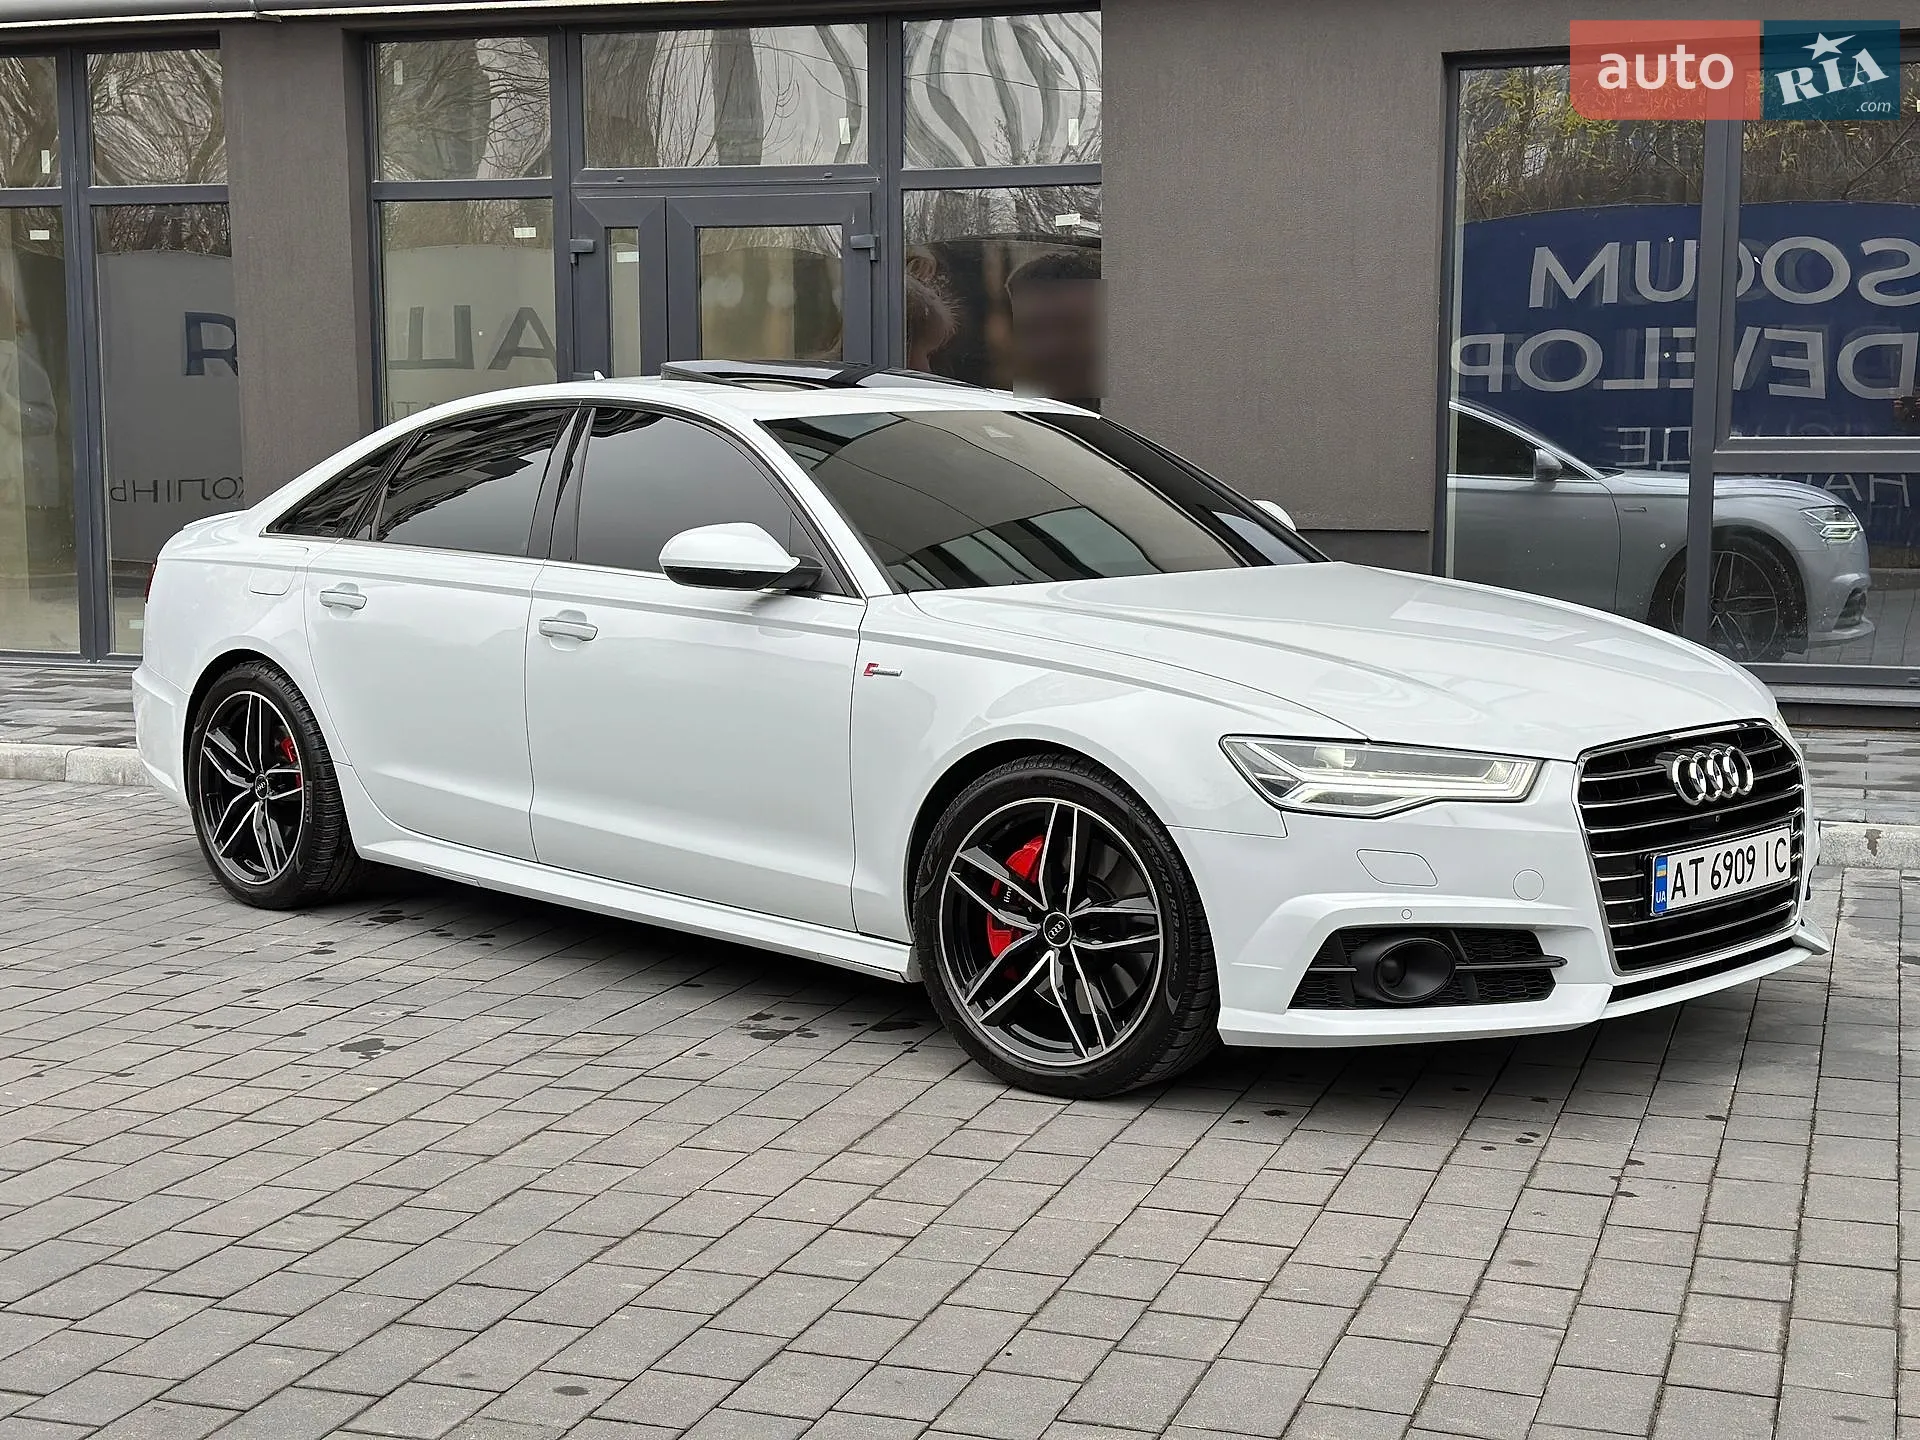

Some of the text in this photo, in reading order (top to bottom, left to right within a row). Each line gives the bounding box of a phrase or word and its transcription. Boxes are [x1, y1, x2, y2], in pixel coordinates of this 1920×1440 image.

[1670, 837, 1787, 900] AT 6909 IC
[1656, 890, 1667, 904] UA
